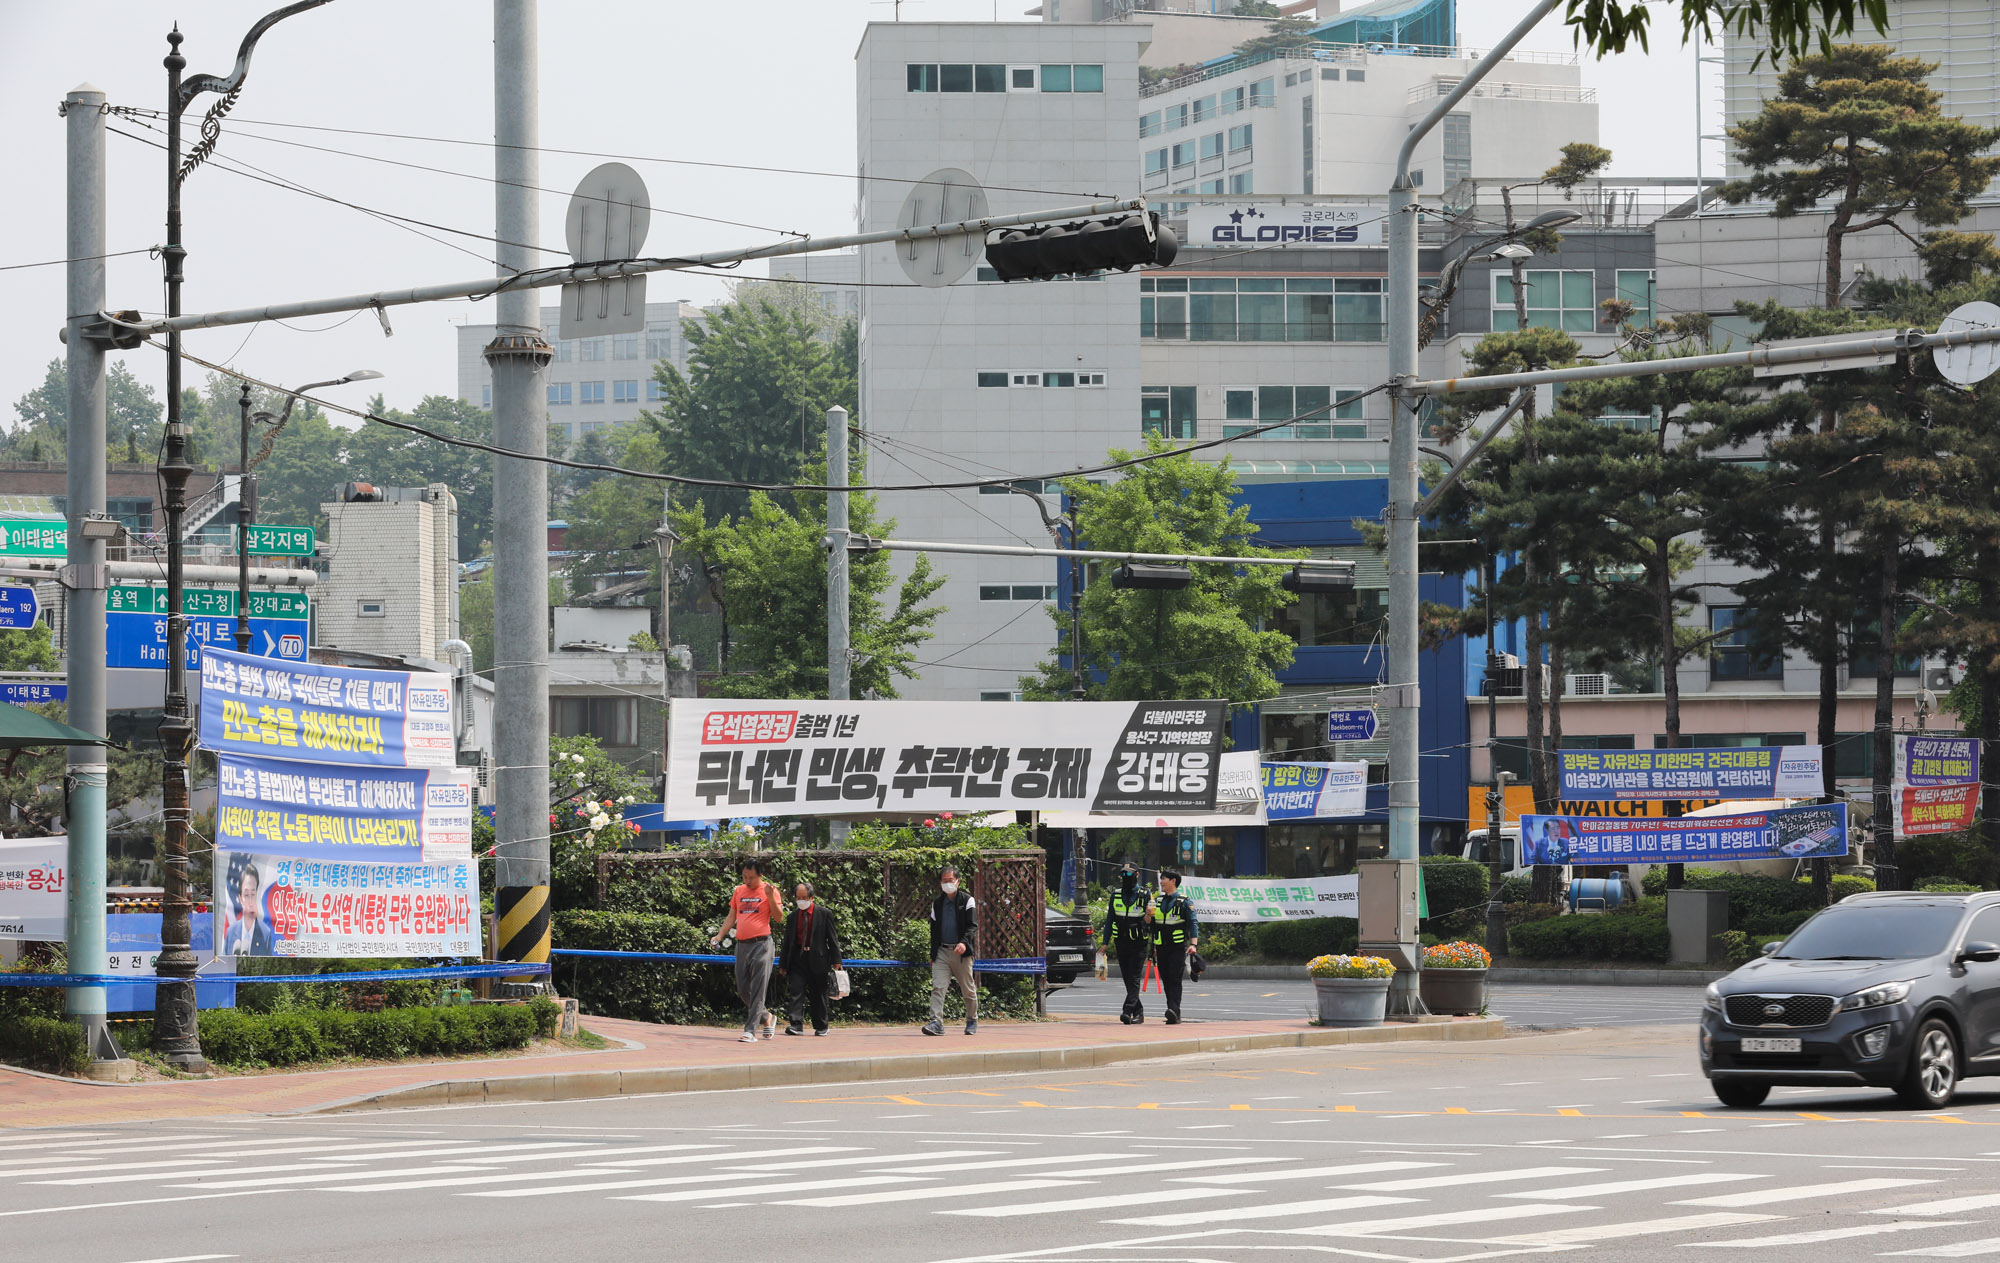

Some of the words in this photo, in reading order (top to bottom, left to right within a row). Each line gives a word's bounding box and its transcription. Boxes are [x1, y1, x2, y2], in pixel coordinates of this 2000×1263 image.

[1302, 211, 1358, 223] 글로리스(주)
[1213, 225, 1359, 243] GLORIES
[12, 528, 67, 549] 이태원역
[247, 530, 308, 551] 삼각지역
[20, 602, 32, 613] 192
[106, 590, 138, 608] 울역
[183, 594, 228, 612] 산구청
[249, 597, 292, 613] 강대교
[154, 620, 231, 643] 한대로
[283, 640, 299, 654] 70
[7, 685, 52, 699] 이태원로
[202, 656, 238, 694] 민노총
[238, 664, 265, 698] 불법
[292, 673, 344, 708] 국민들은
[345, 679, 371, 711] 치를
[412, 693, 446, 708] 자유민주당
[1143, 710, 1207, 725] 더불어민주당
[1331, 712, 1351, 723] 백범로
[222, 699, 299, 747] 민노총을
[300, 709, 385, 755] 해체하라!
[706, 713, 794, 741] 윤석열정권
[794, 713, 832, 738] 출범
[833, 714, 860, 738] 1년
[1126, 731, 1158, 744] 용산구
[1159, 731, 1213, 745] 지역위원장
[1563, 753, 1600, 770] 정부는
[1603, 753, 1652, 770] 자유반공
[1655, 752, 1704, 769] 대한민국
[1708, 751, 1771, 768] 건국대통령
[1783, 762, 1816, 771] 자유민주당
[696, 748, 803, 806] 무너진
[805, 747, 887, 809] 민생,
[892, 745, 1010, 799] 추락한
[1011, 747, 1092, 799] 경제
[1116, 752, 1210, 794] 강태웅
[1273, 766, 1302, 786] 방한
[1334, 775, 1360, 783] 자유민주당
[1565, 772, 1649, 788] 이승만기념관을
[1651, 770, 1714, 788] 용산공원에
[1716, 769, 1772, 787] 건립하라!
[221, 765, 257, 799] 민노총
[257, 770, 308, 805] 불법파업
[308, 776, 358, 808] 뿌리뽑고
[360, 779, 416, 810] 해체하자!
[431, 789, 465, 803] 자유민주당
[1265, 790, 1316, 811] 지지한다!
[219, 806, 255, 839] 사회악
[256, 809, 283, 841] 척결
[283, 813, 349, 845] 노동개혁이
[348, 817, 420, 847] 나라살리기!
[1630, 821, 1660, 830] 70주년!
[1568, 836, 1599, 854] 윤석열
[1601, 834, 1633, 853] 대통령
[1636, 834, 1658, 852] 내외
[1660, 833, 1682, 851] 분을
[1685, 832, 1717, 850] 뜨겁게
[1720, 829, 1780, 850] 환영합니다!
[6, 870, 24, 881] 변화
[25, 868, 65, 893] 용산
[276, 860, 292, 887] 경
[294, 862, 320, 887] 윤석열
[322, 863, 351, 888] 대통령
[351, 864, 370, 888] 취임
[371, 864, 396, 889] 1주년
[395, 864, 450, 889] 축하드립니다
[453, 863, 468, 889] 축
[1206, 886, 1231, 902] 원전
[1229, 887, 1264, 903] 오염수
[1264, 887, 1289, 903] 방류
[1289, 886, 1316, 902] 규탄
[1317, 892, 1337, 902] 대국민
[1337, 892, 1356, 901] 온라인
[320, 892, 352, 935] 윤석열
[353, 893, 388, 935] 대통령
[388, 893, 412, 935] 무한
[413, 893, 471, 935] 응원합니다
[274, 941, 299, 954] 사단법인
[336, 941, 361, 955] 사단법인
